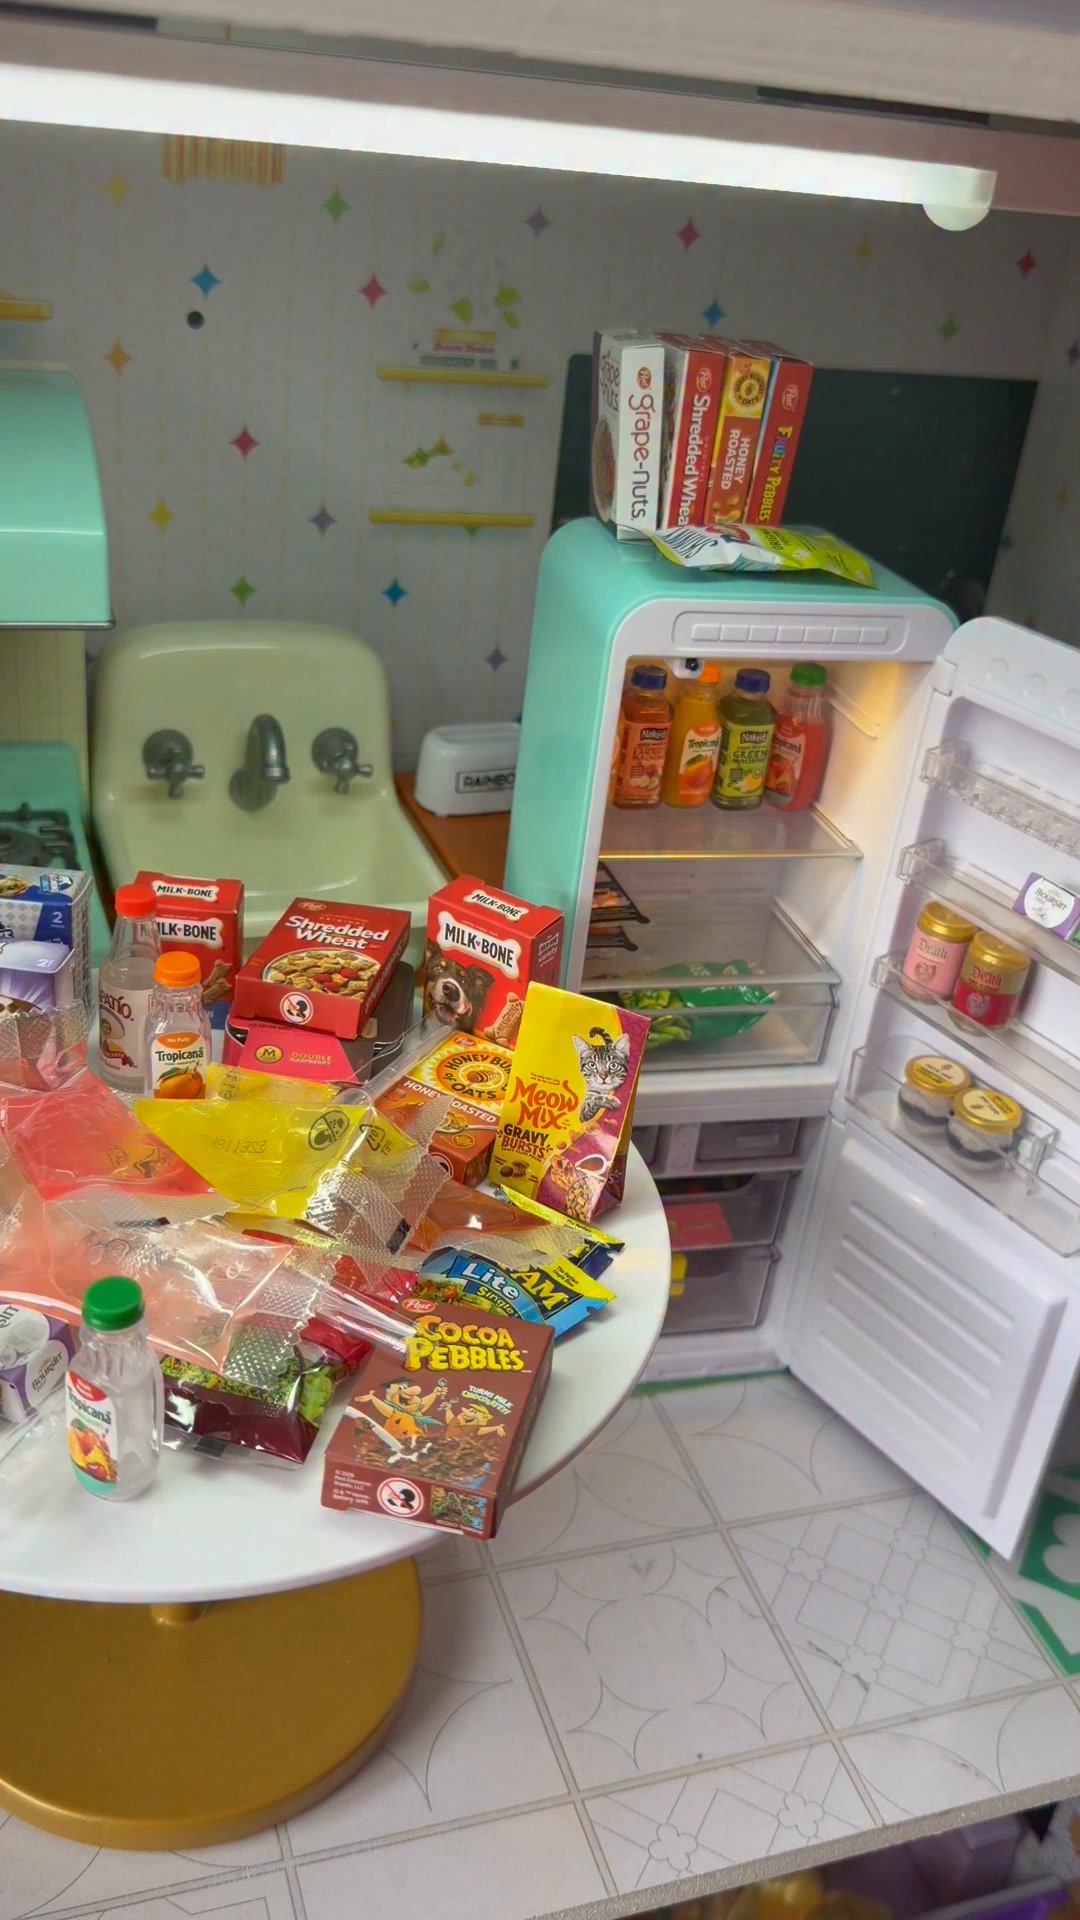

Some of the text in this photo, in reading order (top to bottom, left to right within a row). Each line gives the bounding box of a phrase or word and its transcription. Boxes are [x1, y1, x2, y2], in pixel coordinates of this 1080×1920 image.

[628, 394, 656, 520] grape-nuts
[677, 394, 711, 526] Shredded Whea
[721, 429, 741, 490] ROASTED
[734, 437, 750, 484] HONEY
[758, 475, 783, 522] PEBBLES
[733, 750, 768, 760] GREEN
[463, 771, 515, 787] RAINBO
[52, 911, 63, 923] 2
[285, 915, 390, 941] Shredded
[295, 928, 368, 949] Wheat
[155, 1046, 204, 1062] Tropicana
[262, 1048, 276, 1057] M
[291, 1052, 332, 1062] DOUBLE
[444, 1054, 490, 1071] HONEY
[404, 1080, 444, 1098] HONEY
[451, 1082, 497, 1099] OATS
[509, 1076, 580, 1113] Meow
[451, 1101, 497, 1123] OASTED
[503, 1123, 550, 1146] GRAVY
[501, 1135, 545, 1159] BURSTS
[463, 1262, 520, 1300] Lite
[511, 1270, 567, 1311] AM
[405, 1299, 432, 1311] Post
[477, 1284, 519, 1317] Single
[412, 1314, 515, 1349] COCOA
[403, 1336, 525, 1371] PEBBLES
[468, 1385, 514, 1408] TURNS MILK
